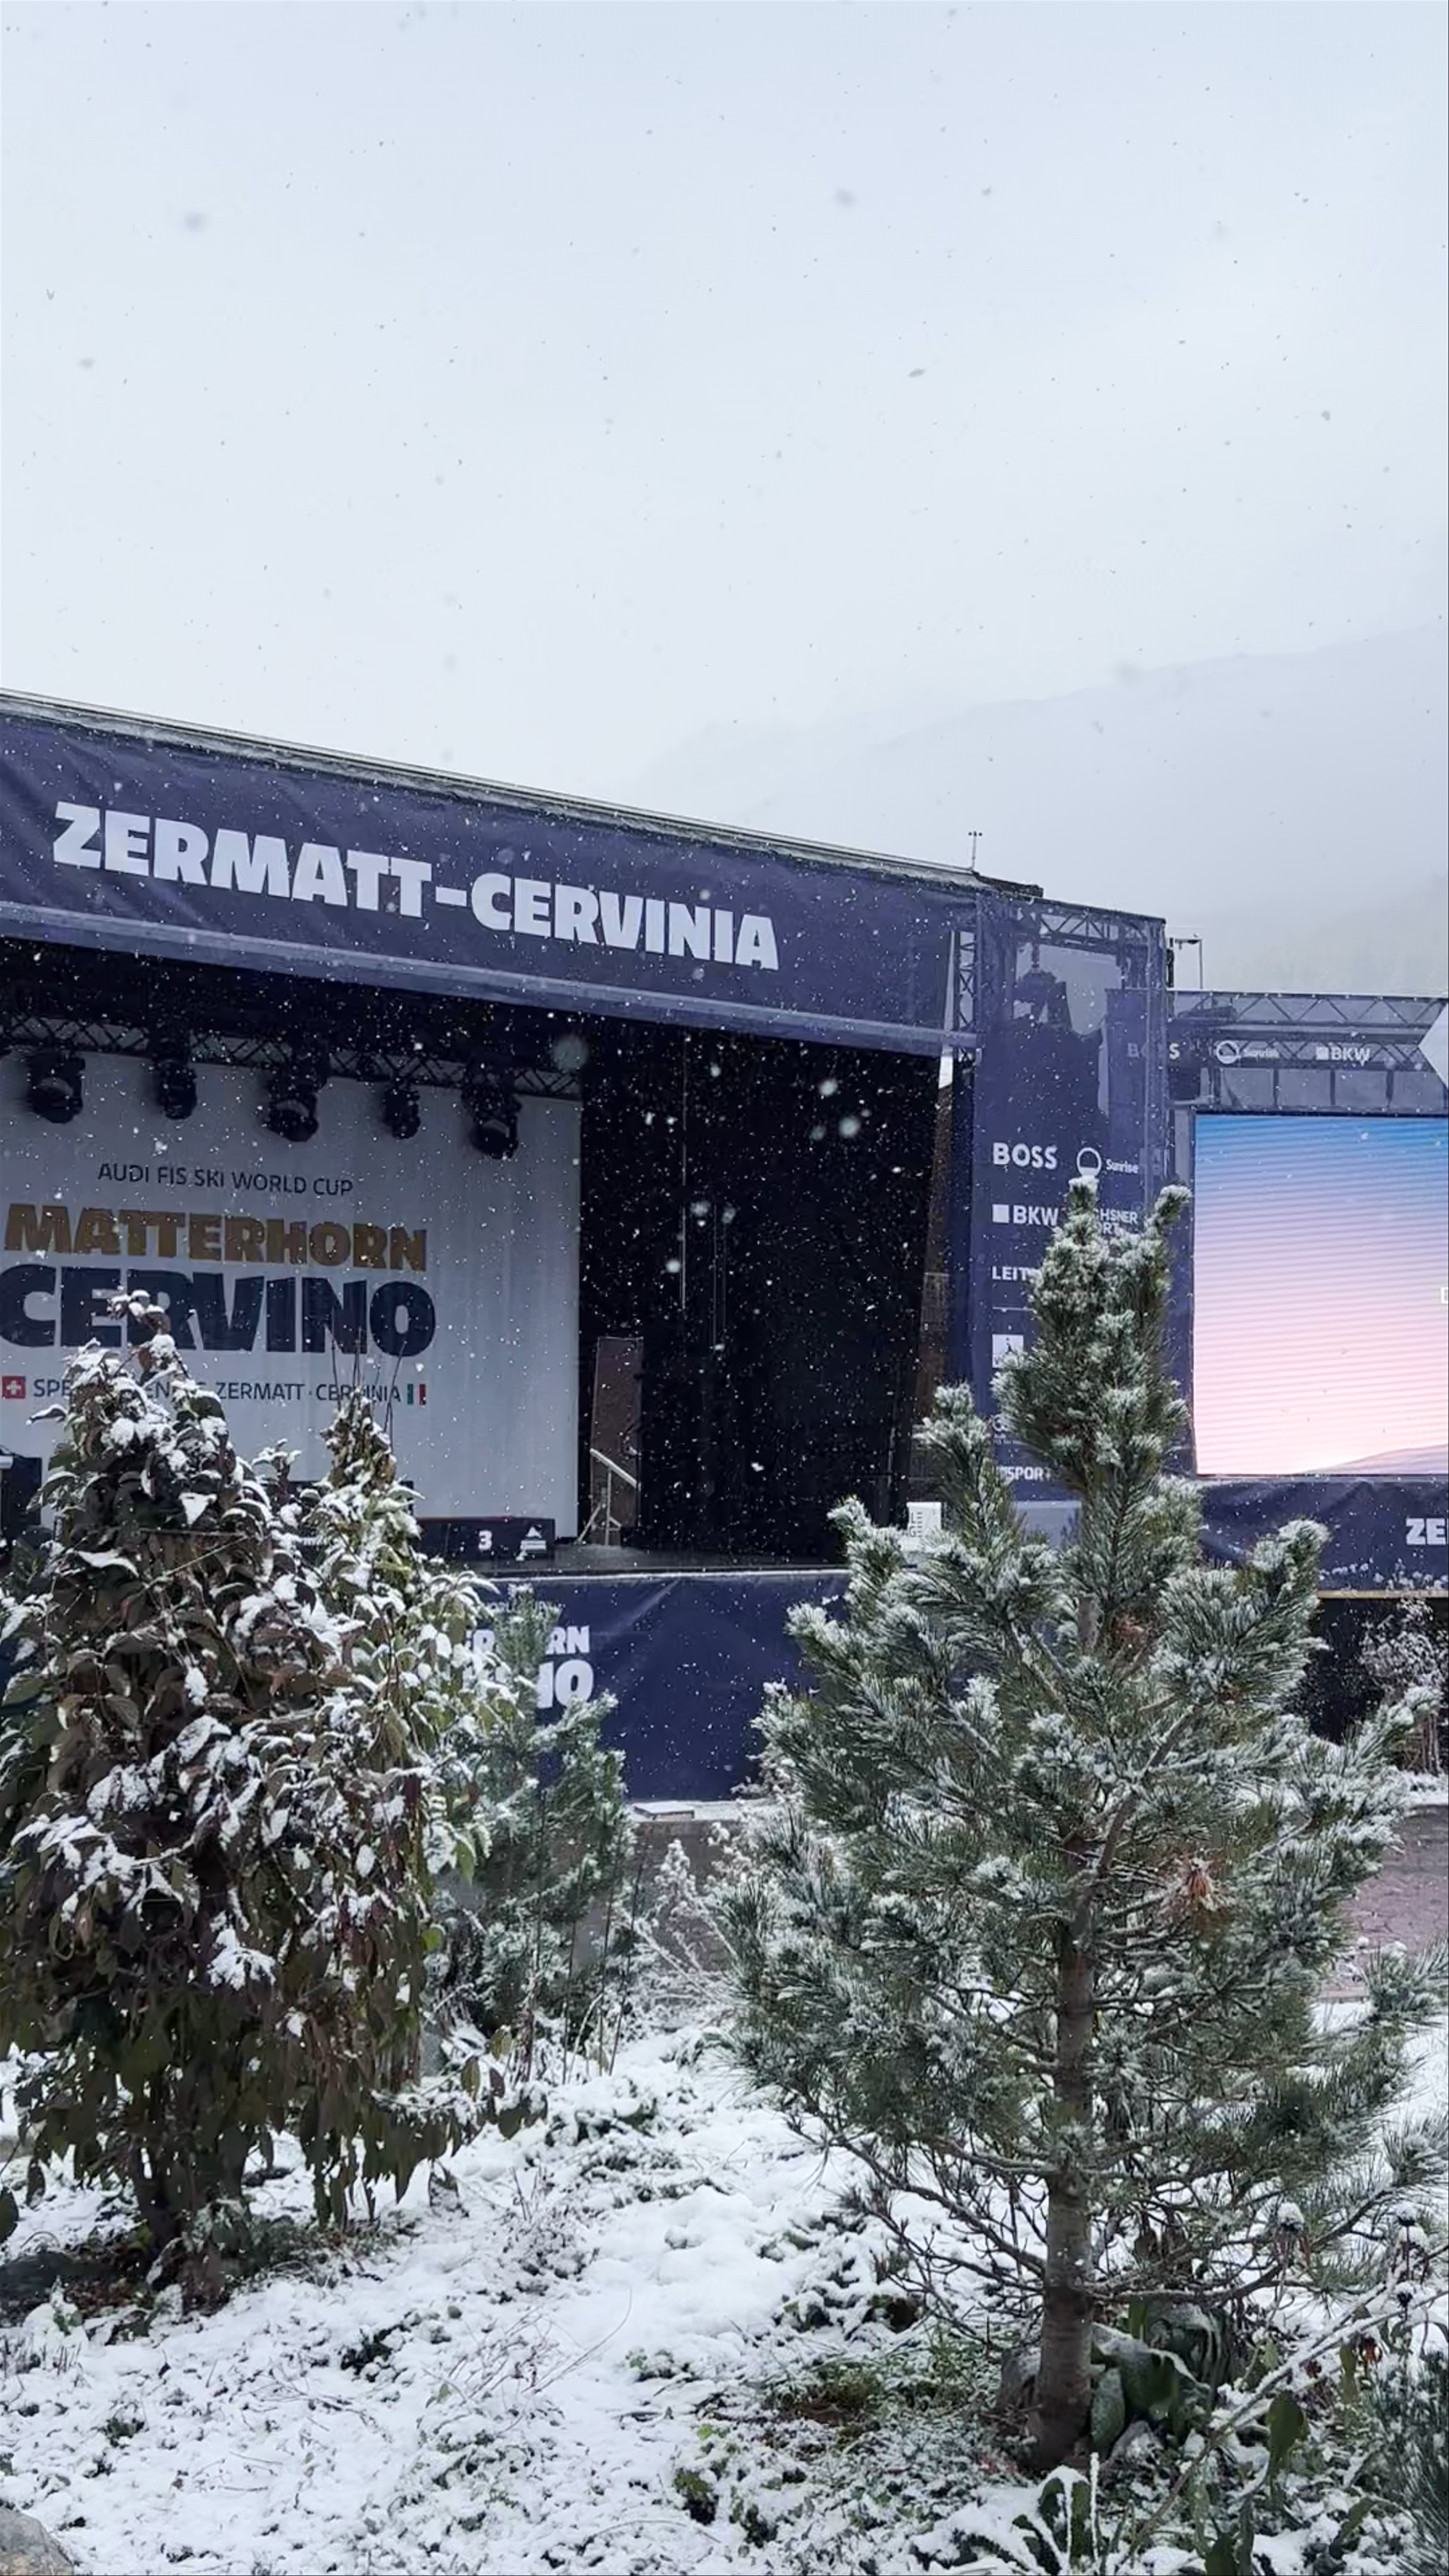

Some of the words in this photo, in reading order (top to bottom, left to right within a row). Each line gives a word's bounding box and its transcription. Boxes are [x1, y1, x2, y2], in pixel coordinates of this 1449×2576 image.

[53, 801, 778, 970] ZERMATT-CERVINIA
[1331, 1046, 1371, 1061] BKW
[994, 1143, 1057, 1169] BOSS
[98, 1163, 149, 1183] AUDI
[158, 1166, 186, 1185] FIS
[194, 1169, 224, 1187] SKI
[231, 1172, 307, 1194] WORLD
[313, 1178, 353, 1196] CUP
[1014, 1205, 1058, 1226] BKW
[4, 1203, 427, 1272] MATTERHORN
[992, 1266, 1029, 1281] LEIT
[0, 1264, 436, 1357] CERVINO
[34, 1379, 71, 1397] SPE
[216, 1382, 305, 1400] ZERMATT
[316, 1384, 401, 1403] CERINIA
[1406, 1518, 1448, 1545] ZE
